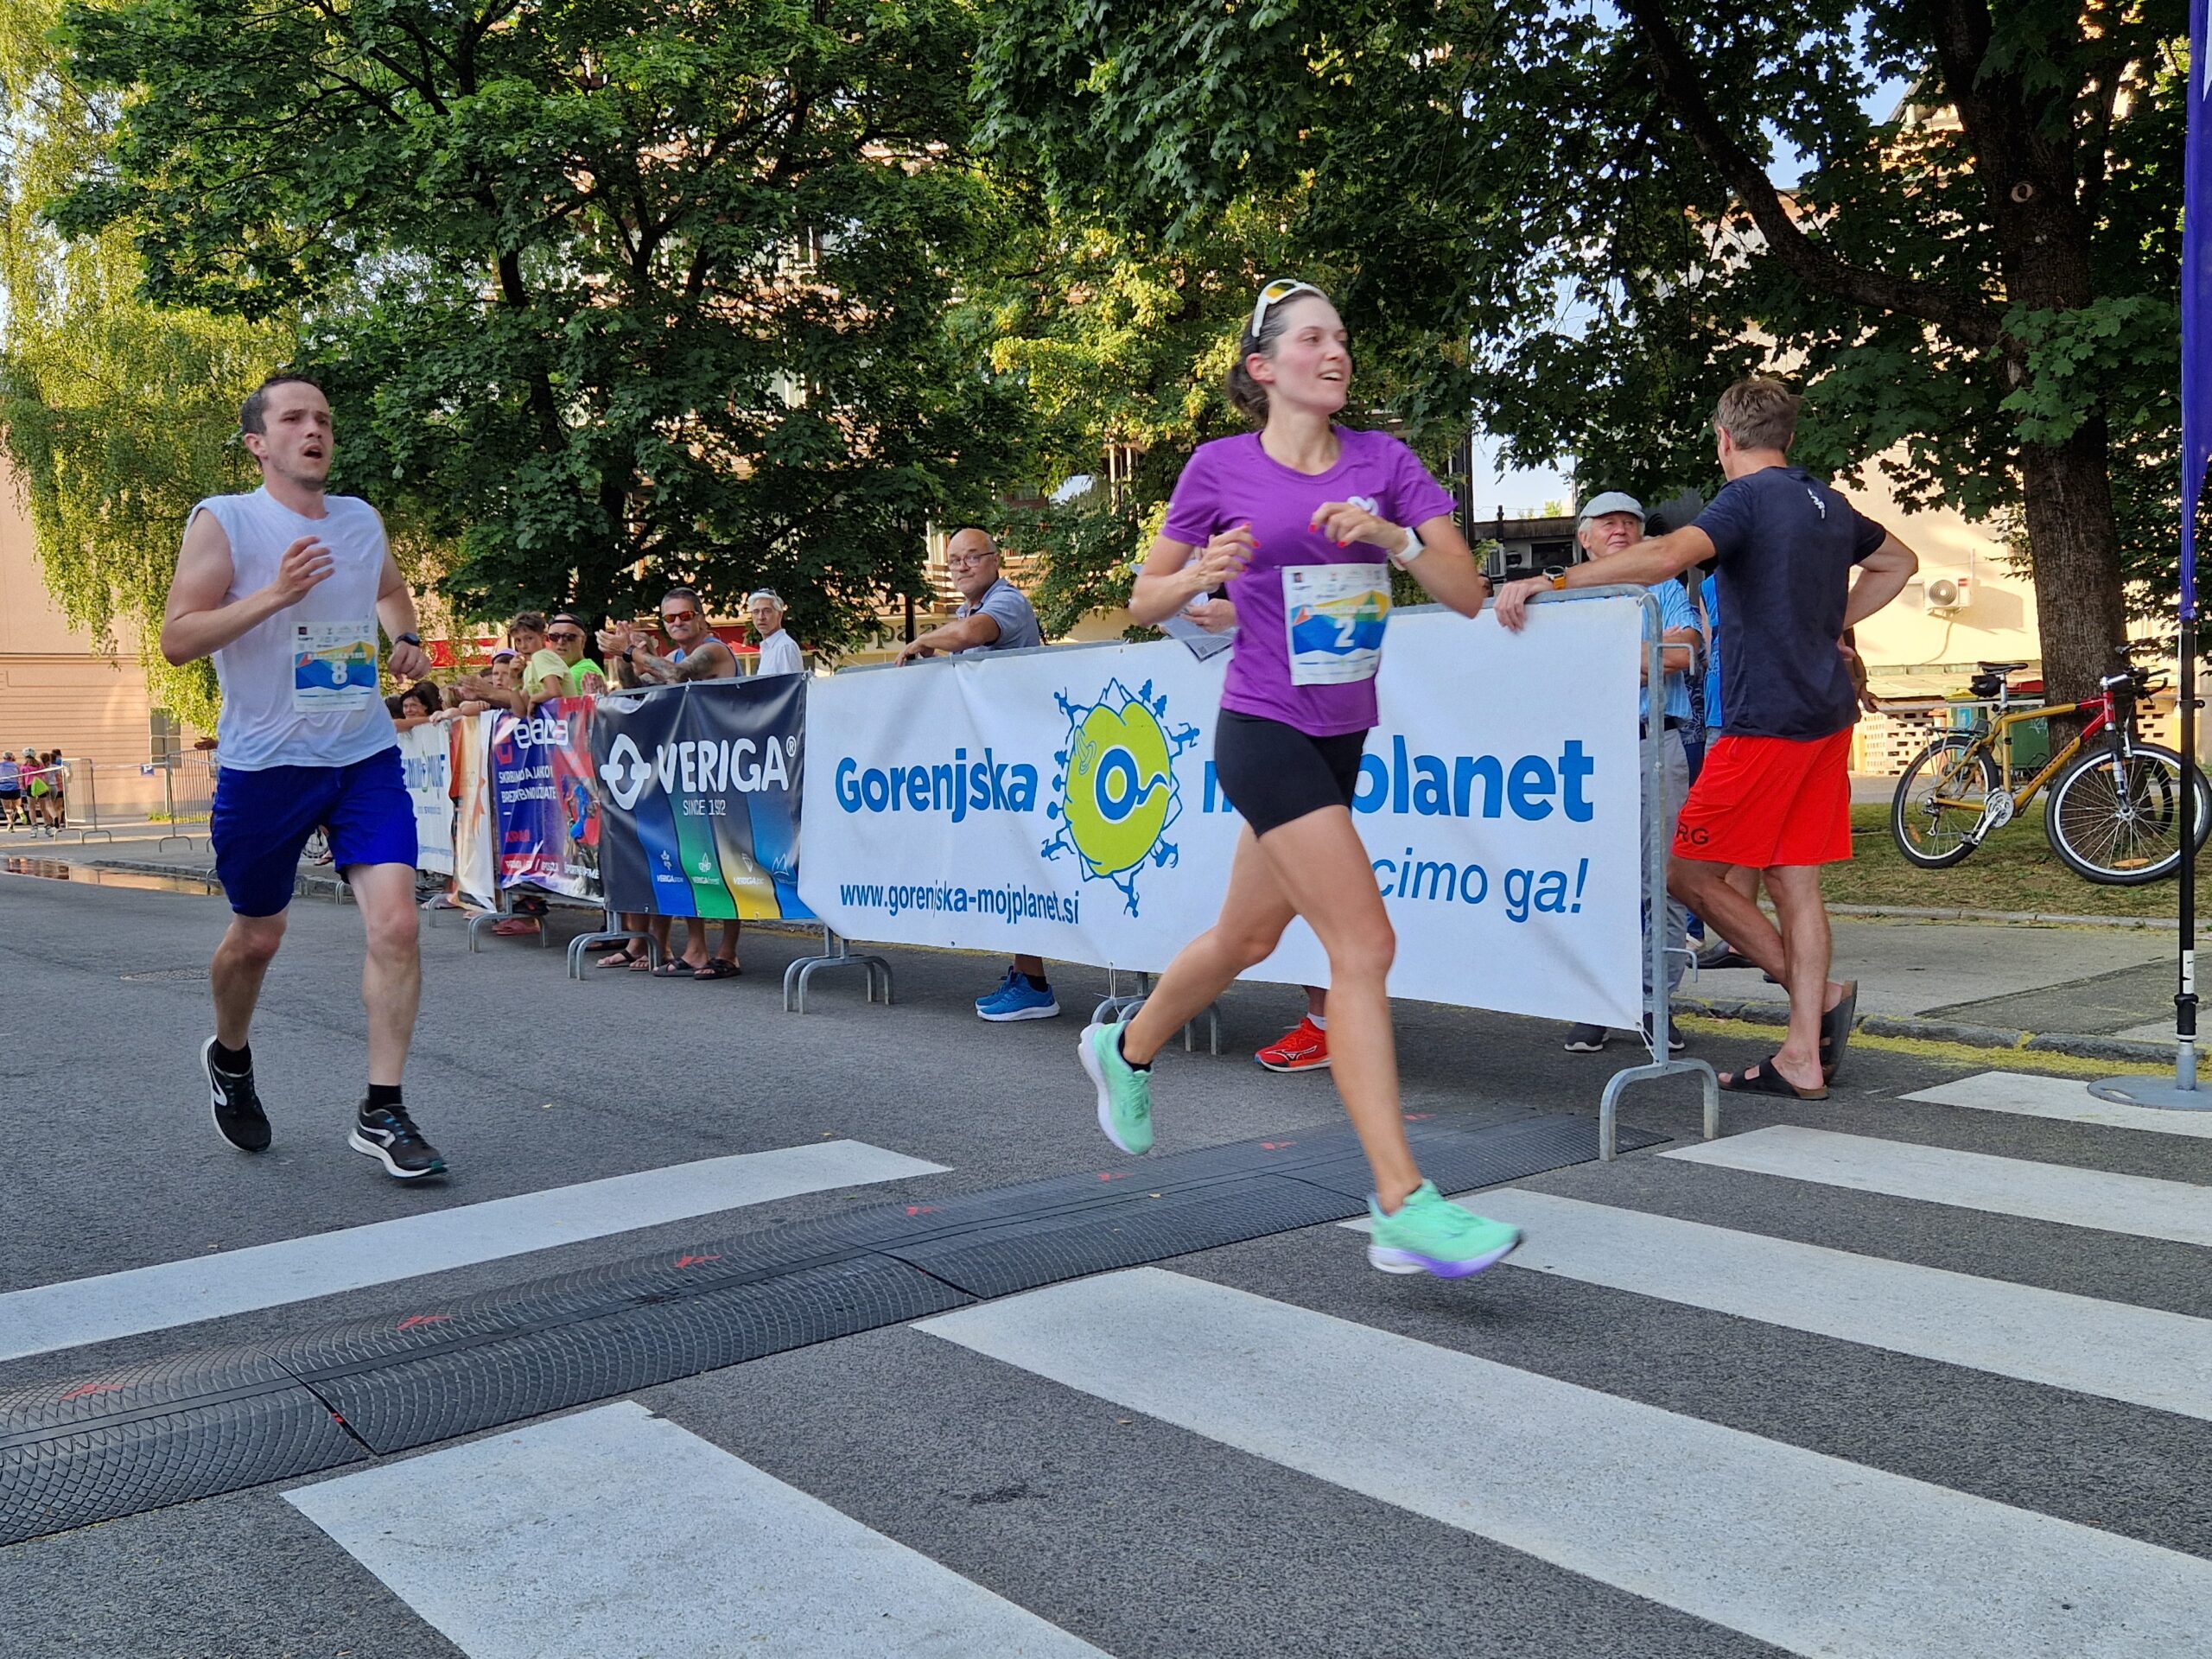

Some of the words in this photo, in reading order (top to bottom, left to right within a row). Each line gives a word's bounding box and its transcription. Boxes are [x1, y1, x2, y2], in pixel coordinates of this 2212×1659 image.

[1333, 618, 1357, 648] 2
[331, 661, 348, 685] 8
[836, 747, 1038, 823] Gorenjska
[840, 880, 1079, 925] www.gorenjska-mojplanet.si
[1503, 857, 1590, 923] ga!
